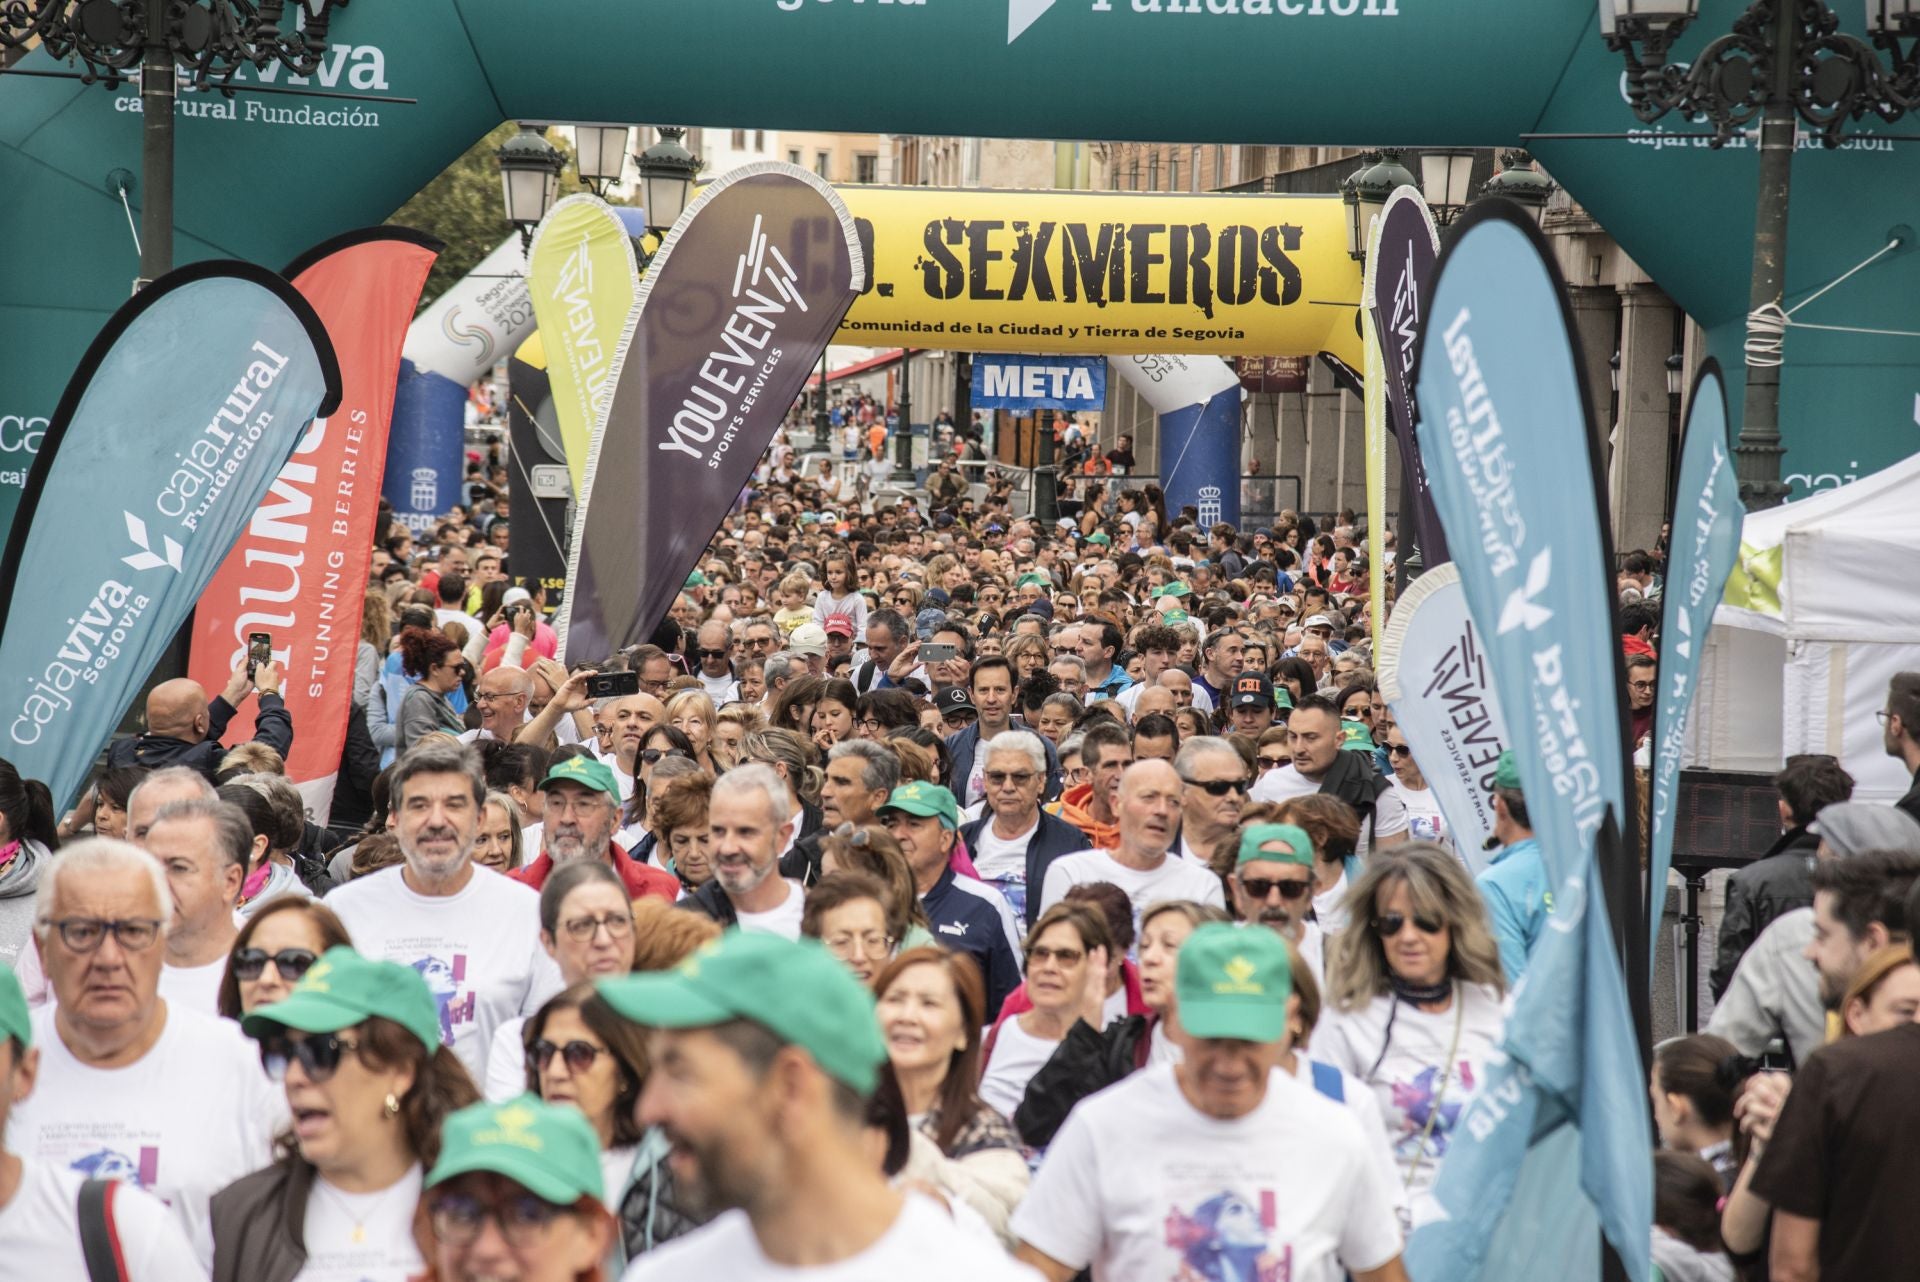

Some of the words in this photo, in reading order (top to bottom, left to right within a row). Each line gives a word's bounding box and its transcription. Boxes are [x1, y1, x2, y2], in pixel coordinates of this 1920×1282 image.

[244, 101, 380, 127] Fundación
[914, 216, 1303, 319] SEXMEROS
[500, 302, 535, 336] 202
[839, 319, 945, 334] Comunidad
[950, 322, 972, 334] de
[977, 323, 994, 335] la
[999, 324, 1063, 336] Ciudad
[1068, 327, 1079, 338] y
[1084, 325, 1140, 338] Tierra
[1145, 327, 1167, 339] de
[1173, 327, 1245, 341] Segovia
[658, 385, 728, 459] YOU
[708, 416, 744, 469] SPORTS
[740, 347, 782, 413] SERVICES
[984, 365, 1095, 399] META
[156, 340, 289, 518] cajarural
[181, 410, 274, 533] Fundación
[309, 551, 344, 698] STUNNING
[332, 409, 367, 536] BERRIES
[10, 579, 132, 745] cajaviva
[83, 594, 150, 684] Segovia
[1238, 679, 1261, 692] CHI
